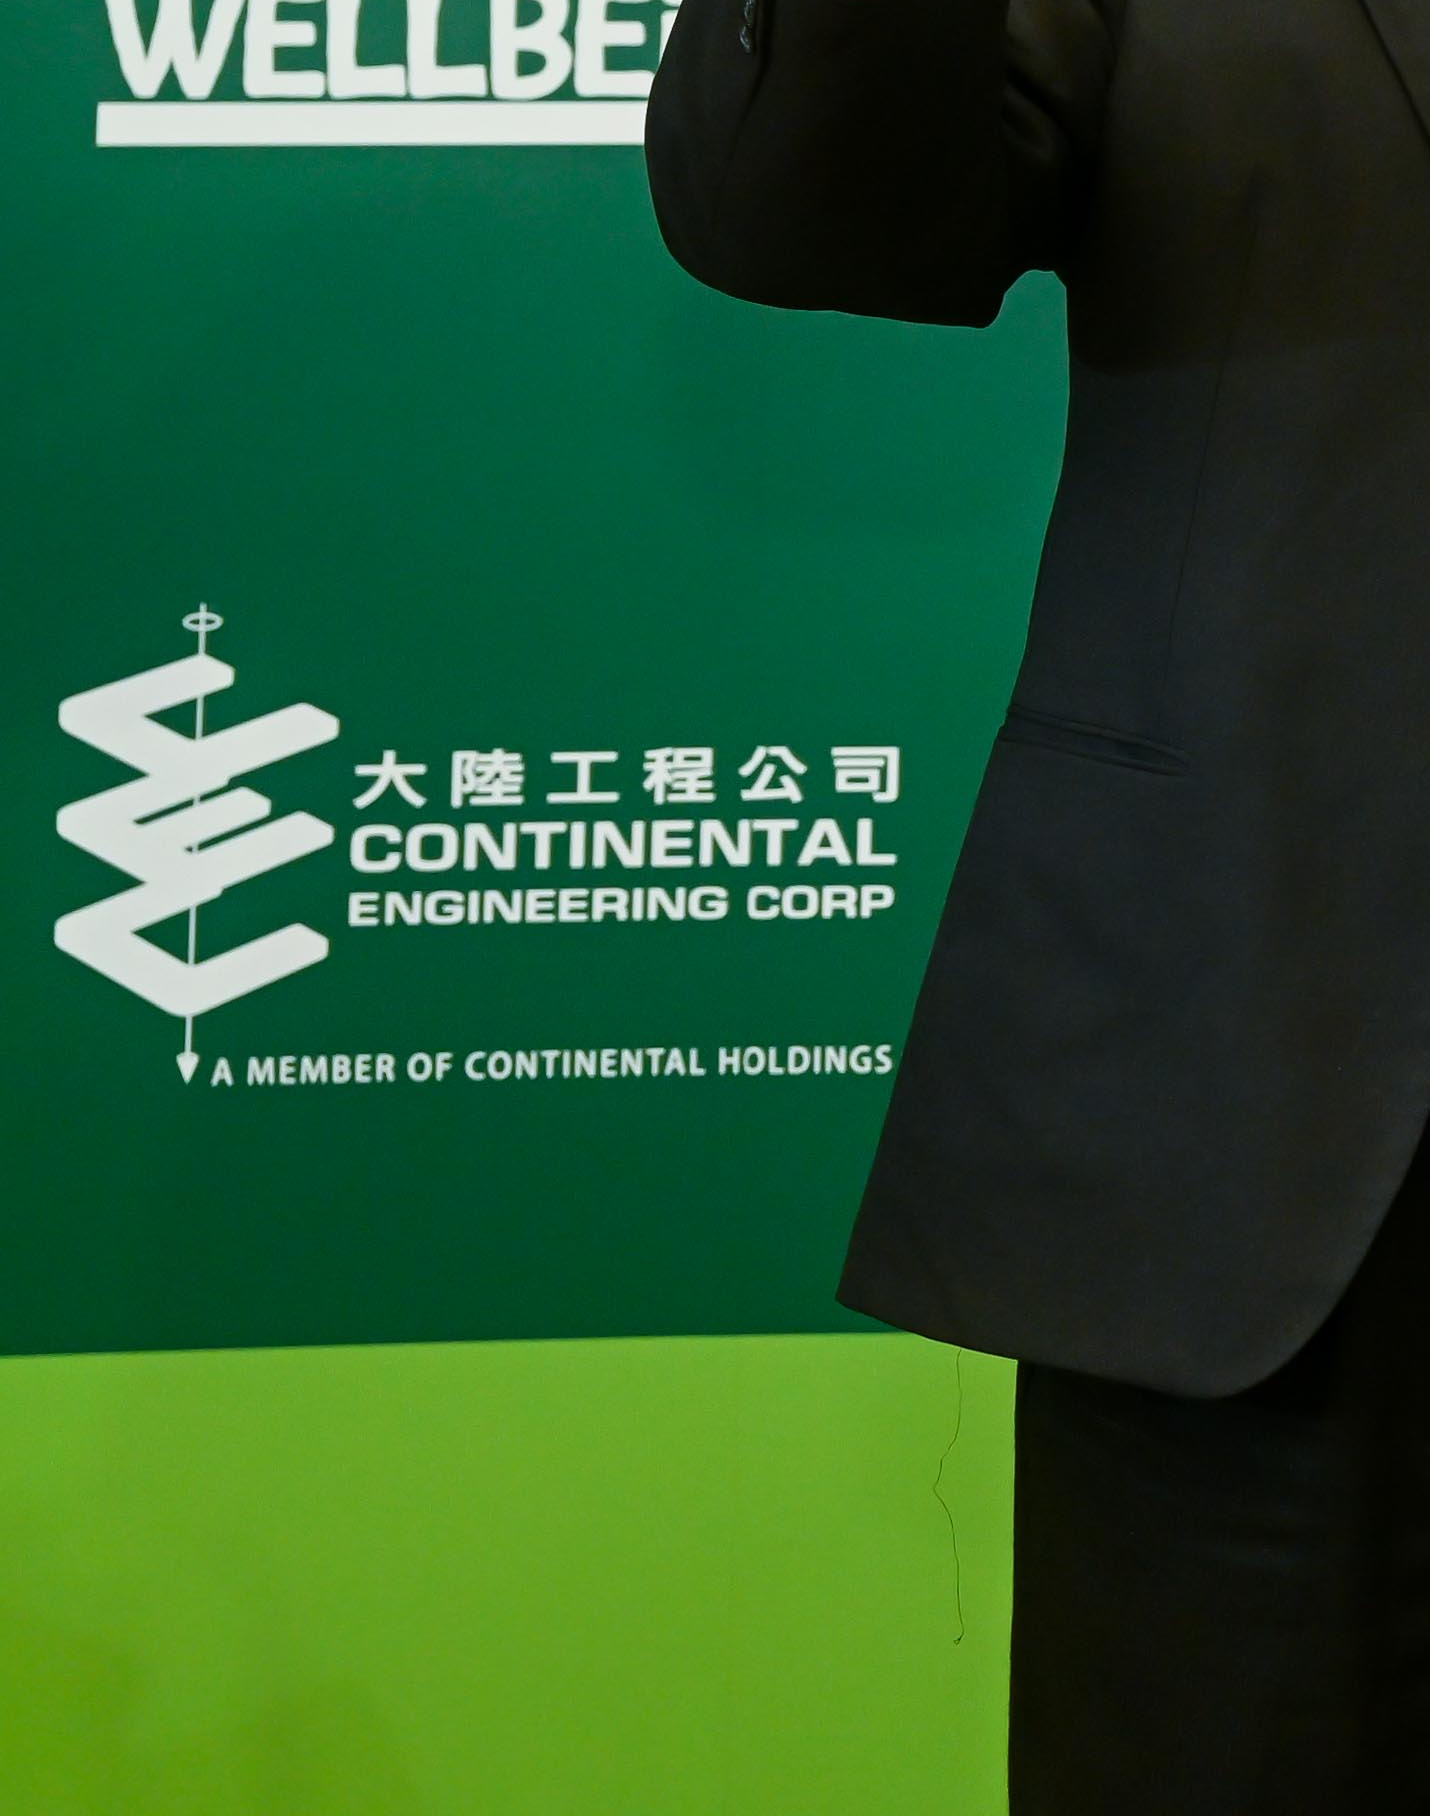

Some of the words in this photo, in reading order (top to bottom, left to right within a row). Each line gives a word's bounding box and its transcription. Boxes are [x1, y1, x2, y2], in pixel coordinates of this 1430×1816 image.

[352, 745, 900, 809] 大陸工程公司
[350, 817, 897, 873] CONTINENTAL
[348, 885, 729, 927] ENGINEERING
[747, 884, 895, 920] CORP
[211, 1057, 233, 1086] A
[247, 1053, 395, 1086] MEMBER
[407, 1052, 453, 1082] OF
[464, 1047, 706, 1081] CONTINENTAL
[718, 1044, 893, 1076] HOLDINGS
